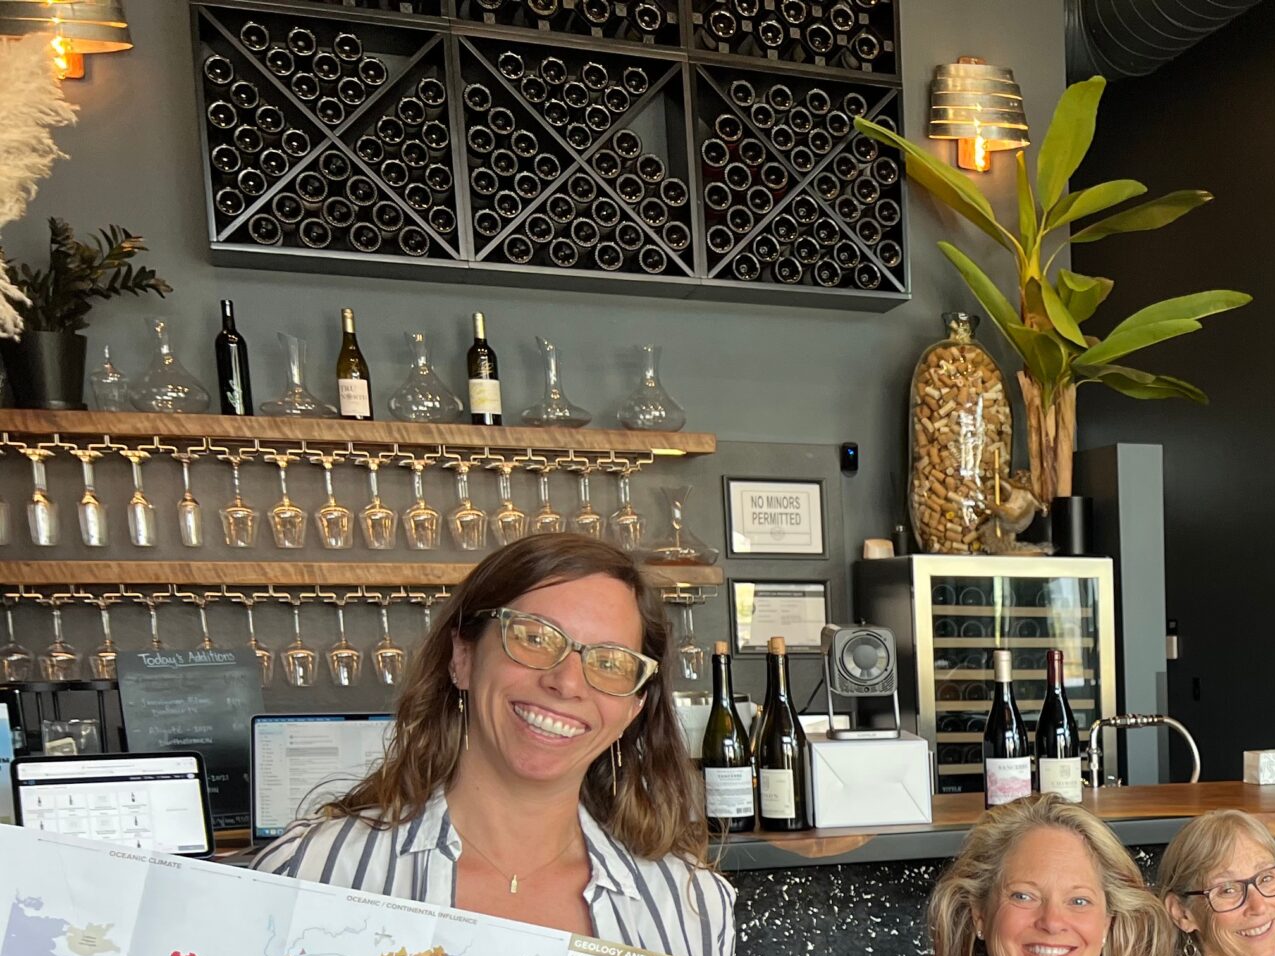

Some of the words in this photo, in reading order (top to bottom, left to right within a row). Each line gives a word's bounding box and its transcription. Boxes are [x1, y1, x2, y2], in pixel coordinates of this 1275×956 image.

[751, 496, 764, 509] NO
[766, 496, 801, 509] MINORS
[752, 512, 801, 525] PERMITTED
[137, 653, 184, 668] Today's
[188, 650, 235, 663] Additions
[109, 851, 147, 863] OCEANIC
[148, 856, 182, 870] CLIMATE
[346, 895, 380, 907] OCEANIC
[386, 902, 436, 918] CONTINENTAL
[437, 911, 478, 925] INFLUENCE
[574, 940, 623, 956] GEOLOGY
